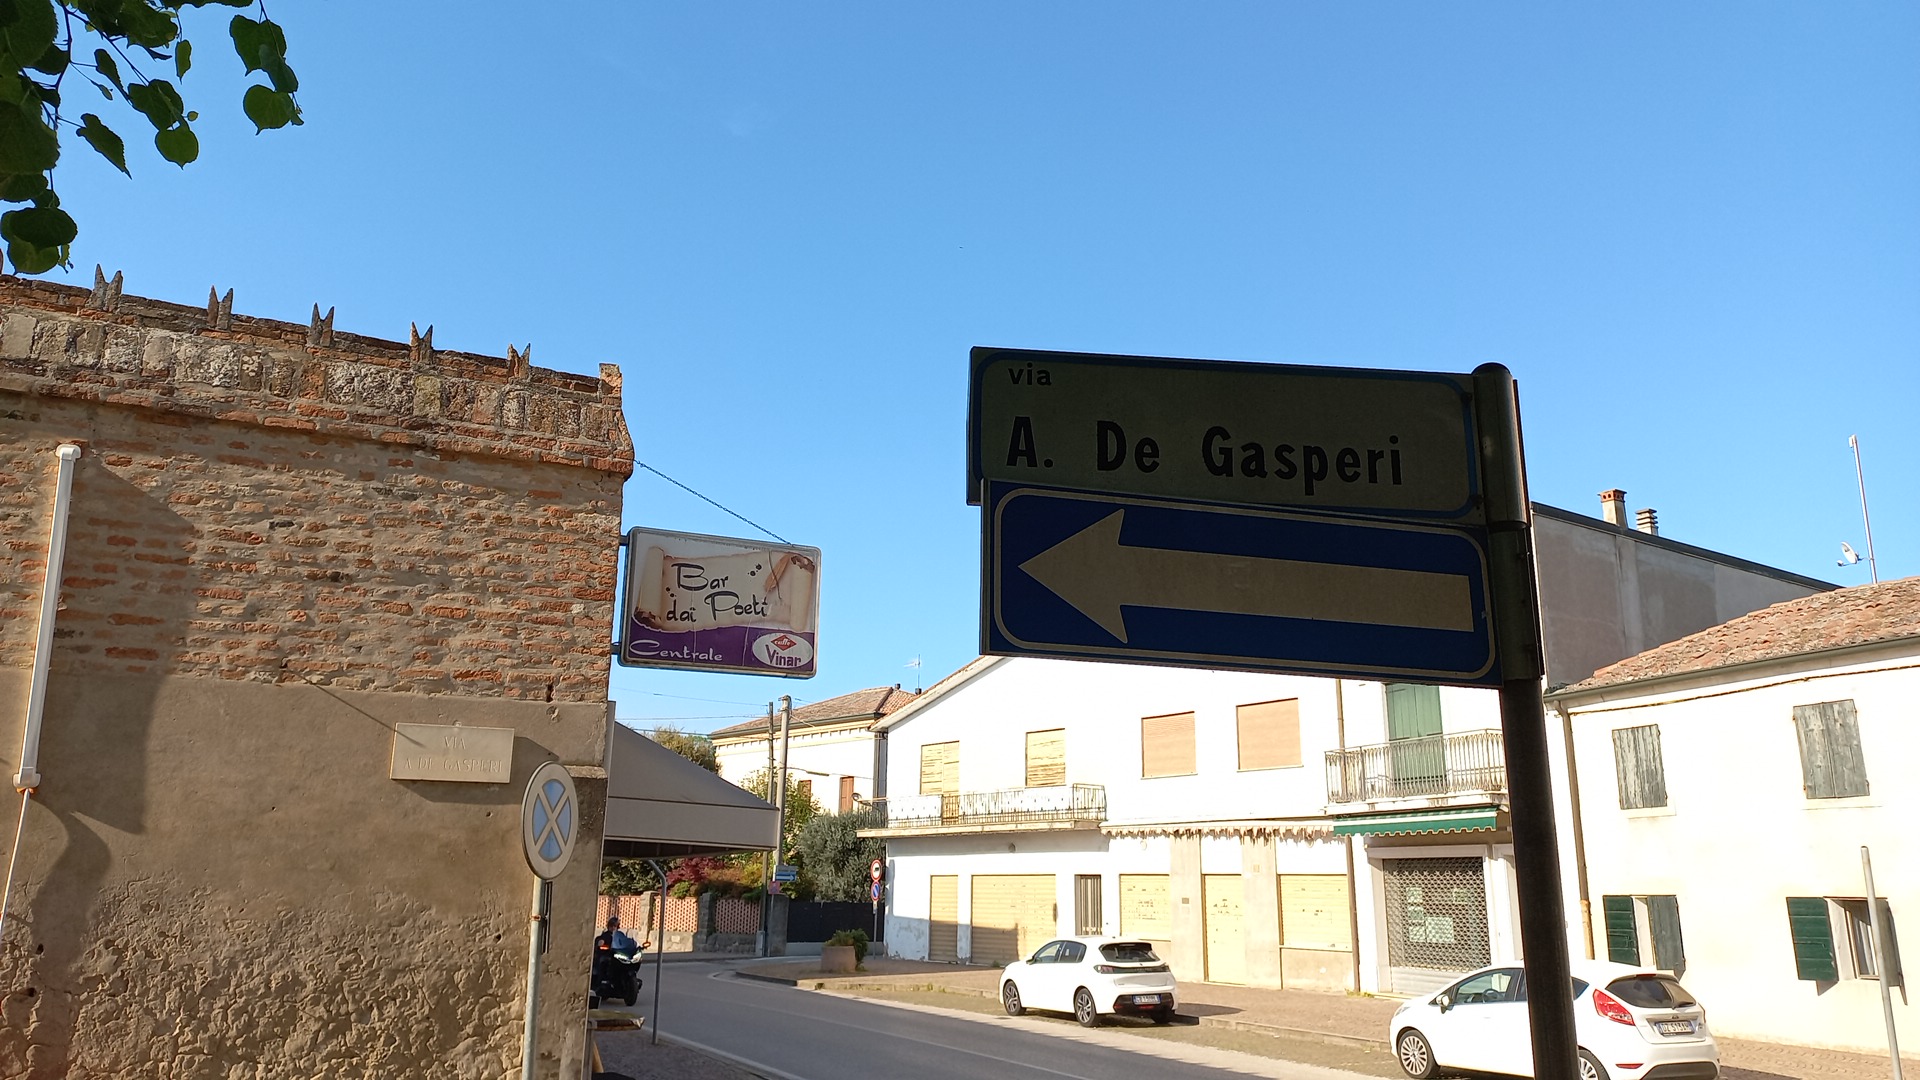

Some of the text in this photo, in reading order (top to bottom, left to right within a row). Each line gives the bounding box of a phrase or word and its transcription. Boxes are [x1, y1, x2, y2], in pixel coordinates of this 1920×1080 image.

[1007, 362, 1052, 386] via
[1006, 416, 1402, 496] A. De Gasperi
[671, 562, 729, 591] Bar
[704, 591, 768, 621] Poeti
[629, 639, 723, 662] Centrale
[765, 644, 801, 667] Vinar
[443, 736, 466, 749] VIA
[443, 758, 502, 772] GASPERI
